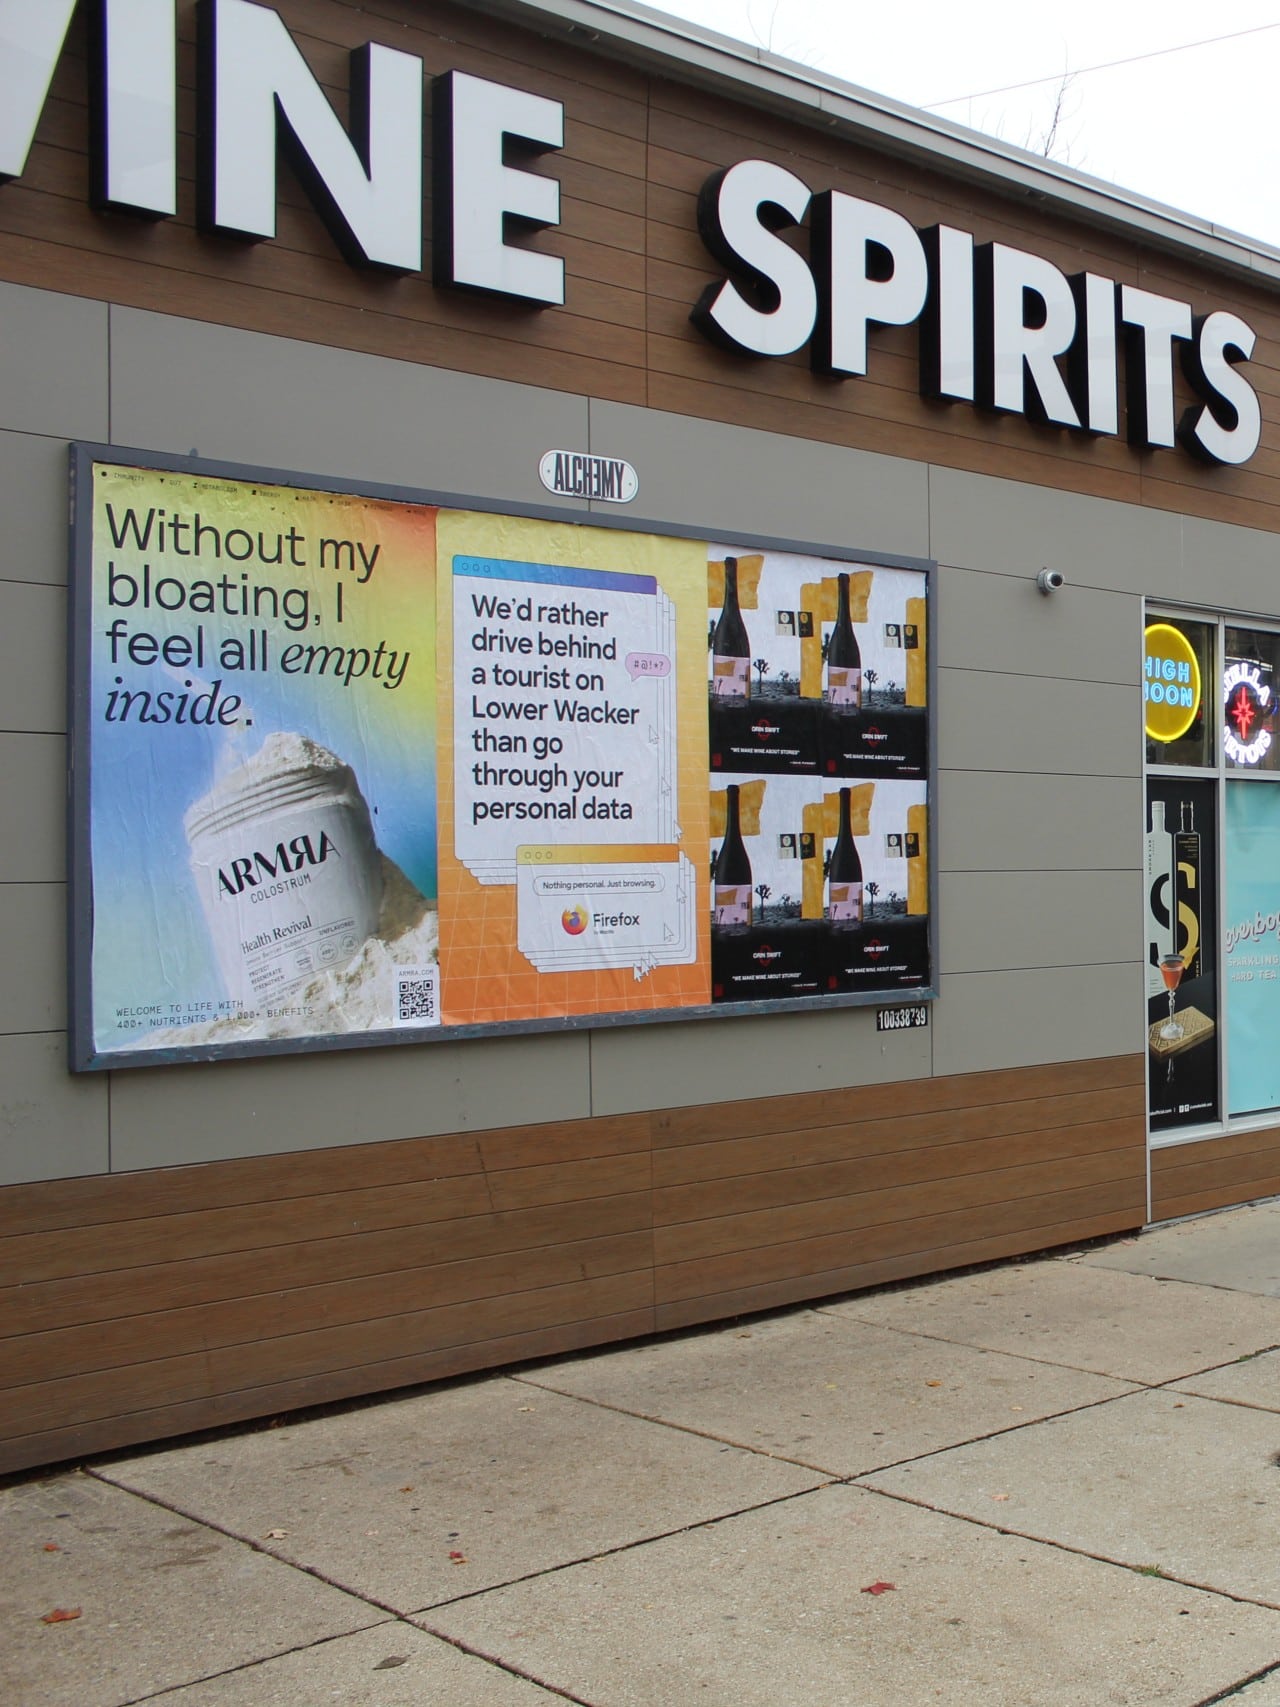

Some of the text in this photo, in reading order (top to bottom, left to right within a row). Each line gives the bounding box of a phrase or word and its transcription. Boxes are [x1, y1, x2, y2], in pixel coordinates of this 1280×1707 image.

[706, 158, 1262, 465] SPIRITS
[105, 503, 380, 584] Without my
[108, 561, 344, 631] bloating, I
[471, 594, 609, 628] We’d rather
[105, 619, 411, 689] feel all empty
[471, 627, 617, 661] drive behind
[471, 663, 604, 691] a tourist on
[1144, 656, 1190, 683] HIGH
[104, 676, 253, 727] inside.
[472, 695, 640, 725] Lower Wacker
[472, 727, 563, 760] than go
[472, 761, 624, 793] through your
[472, 796, 633, 826] personal data
[250, 872, 312, 905] COLOSTRUM
[542, 879, 657, 891] Nothing personal. Just browsing.
[241, 914, 312, 955] Health Revival
[593, 911, 640, 928] Firefox
[399, 969, 434, 977] ARMRA.COM
[1259, 970, 1277, 980] TEA
[116, 1000, 244, 1017] WELCOME TO LIFE WITH
[117, 1019, 143, 1029] 400+
[149, 1015, 207, 1027] NUTRIENTS
[213, 1013, 219, 1022] &
[267, 1006, 314, 1018] BENEFITS
